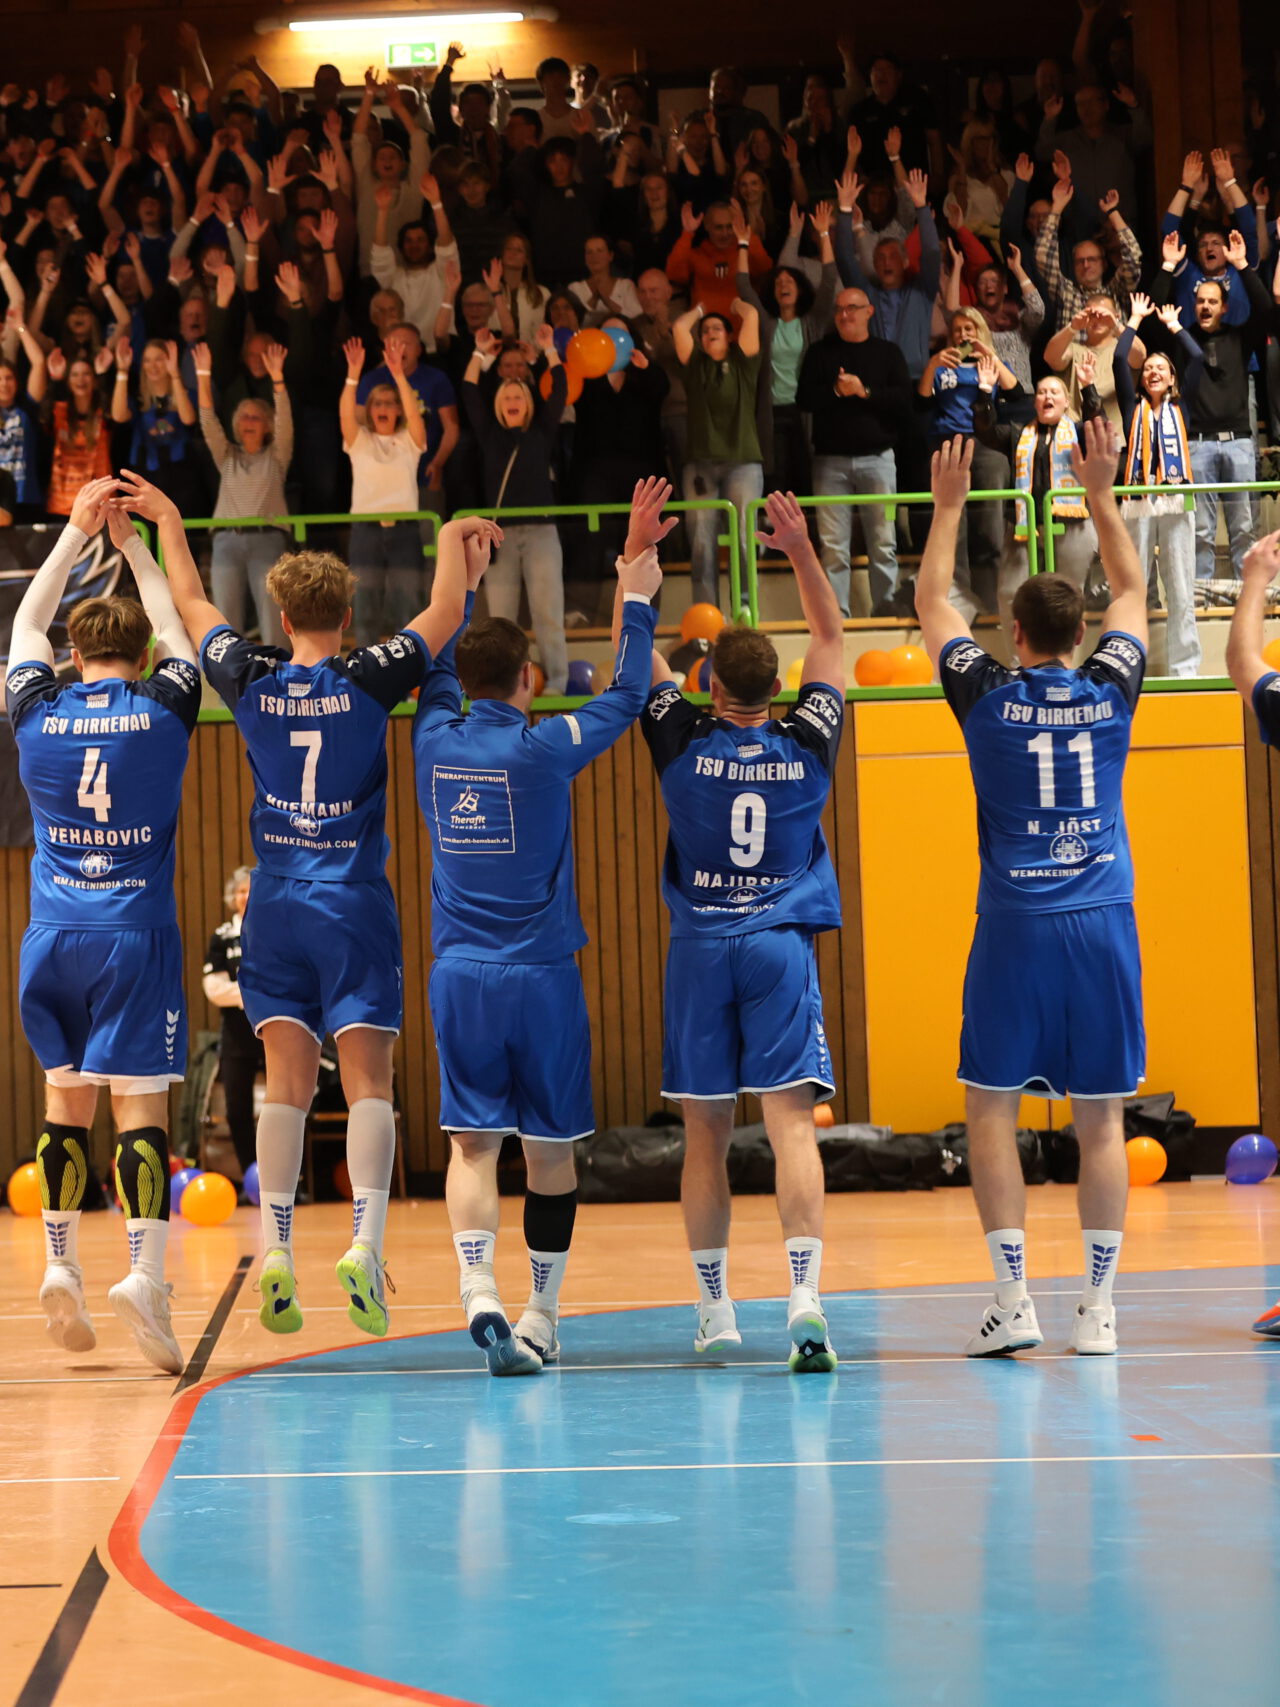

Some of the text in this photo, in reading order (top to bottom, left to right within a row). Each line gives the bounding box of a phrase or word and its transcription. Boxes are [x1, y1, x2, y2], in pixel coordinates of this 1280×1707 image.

[260, 693, 285, 716] TSV
[1003, 700, 1113, 725] TSV BIRKENAU
[42, 712, 151, 735] TSV BIRKENAU
[290, 731, 322, 803] 7
[435, 772, 505, 783] THERAPIEZENTRUM
[695, 755, 805, 781] TSV BIRKENAU
[1027, 731, 1096, 808] 11
[77, 747, 112, 823] 4
[450, 815, 487, 826] Therafit
[729, 792, 767, 868] 9
[48, 826, 152, 847] VEHABOVIC
